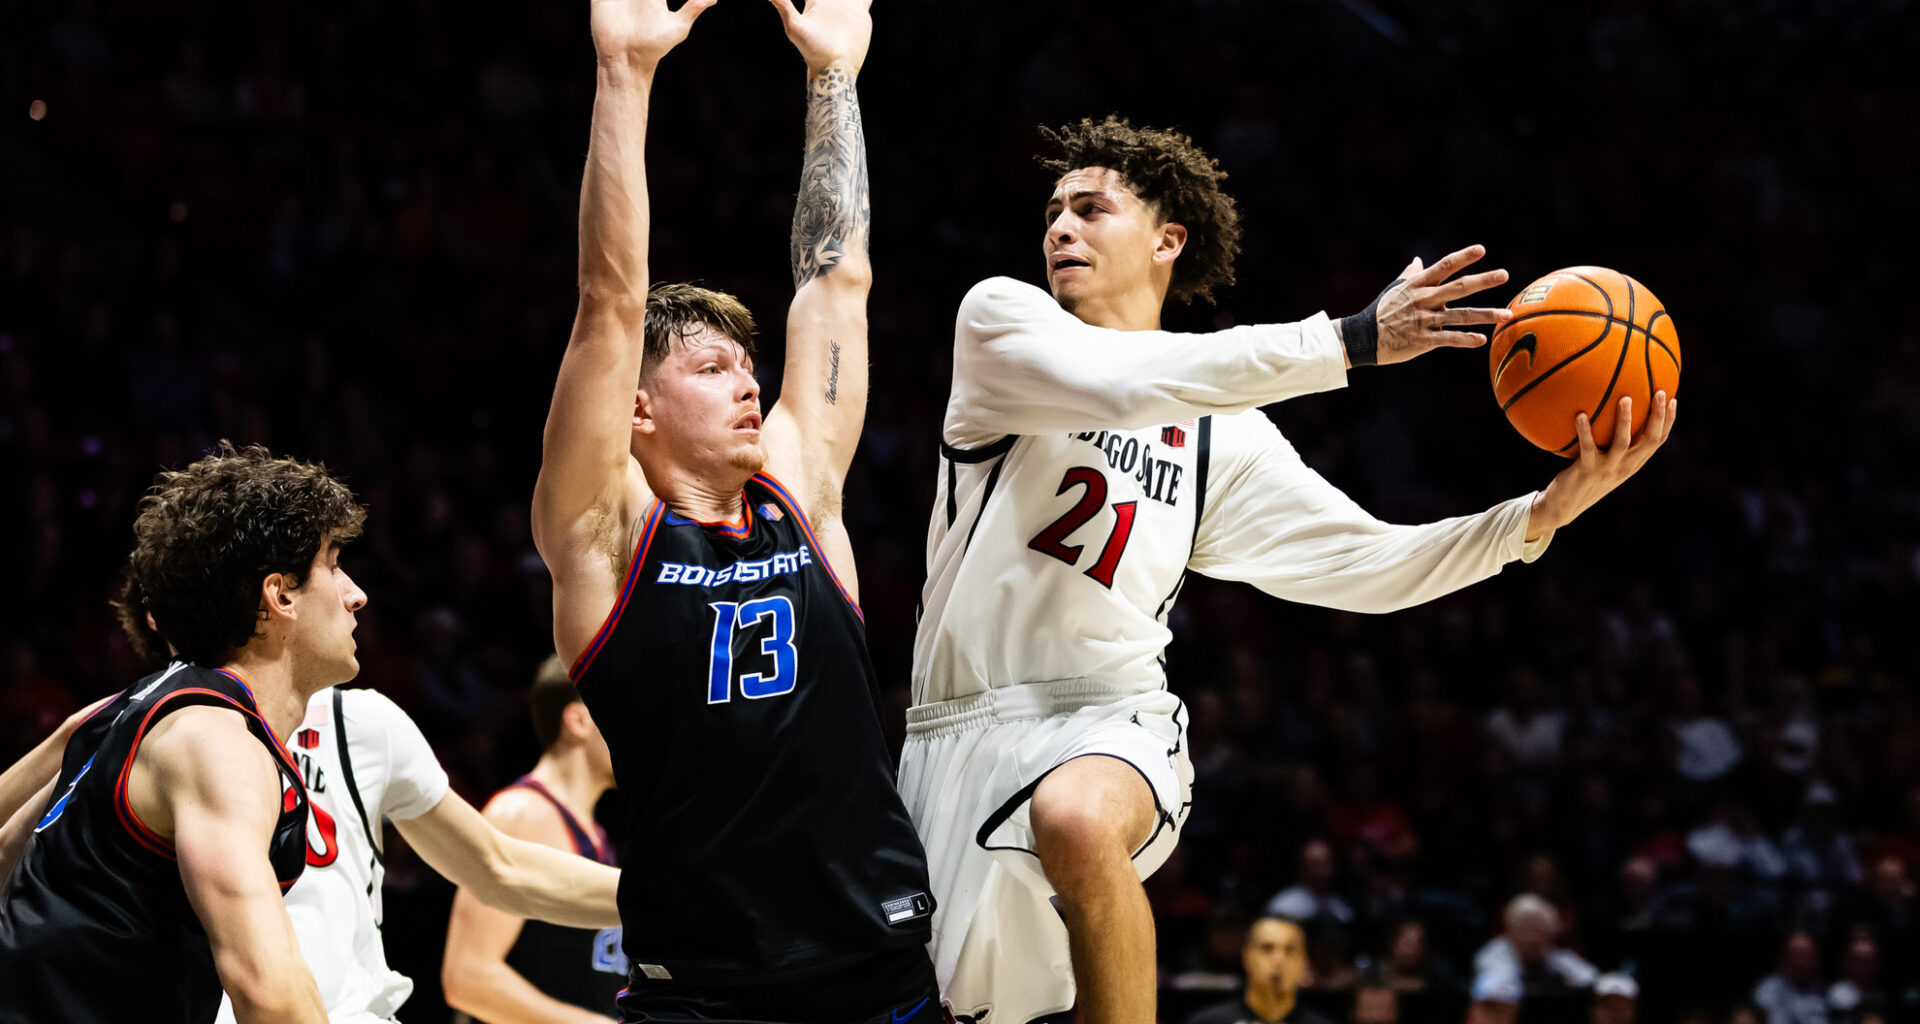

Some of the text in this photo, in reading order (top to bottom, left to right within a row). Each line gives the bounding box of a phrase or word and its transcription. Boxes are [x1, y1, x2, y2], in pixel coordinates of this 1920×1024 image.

[740, 544, 812, 583] STATE
[1027, 466, 1138, 590] 21
[707, 595, 798, 704] 13
[916, 900, 925, 910] L
